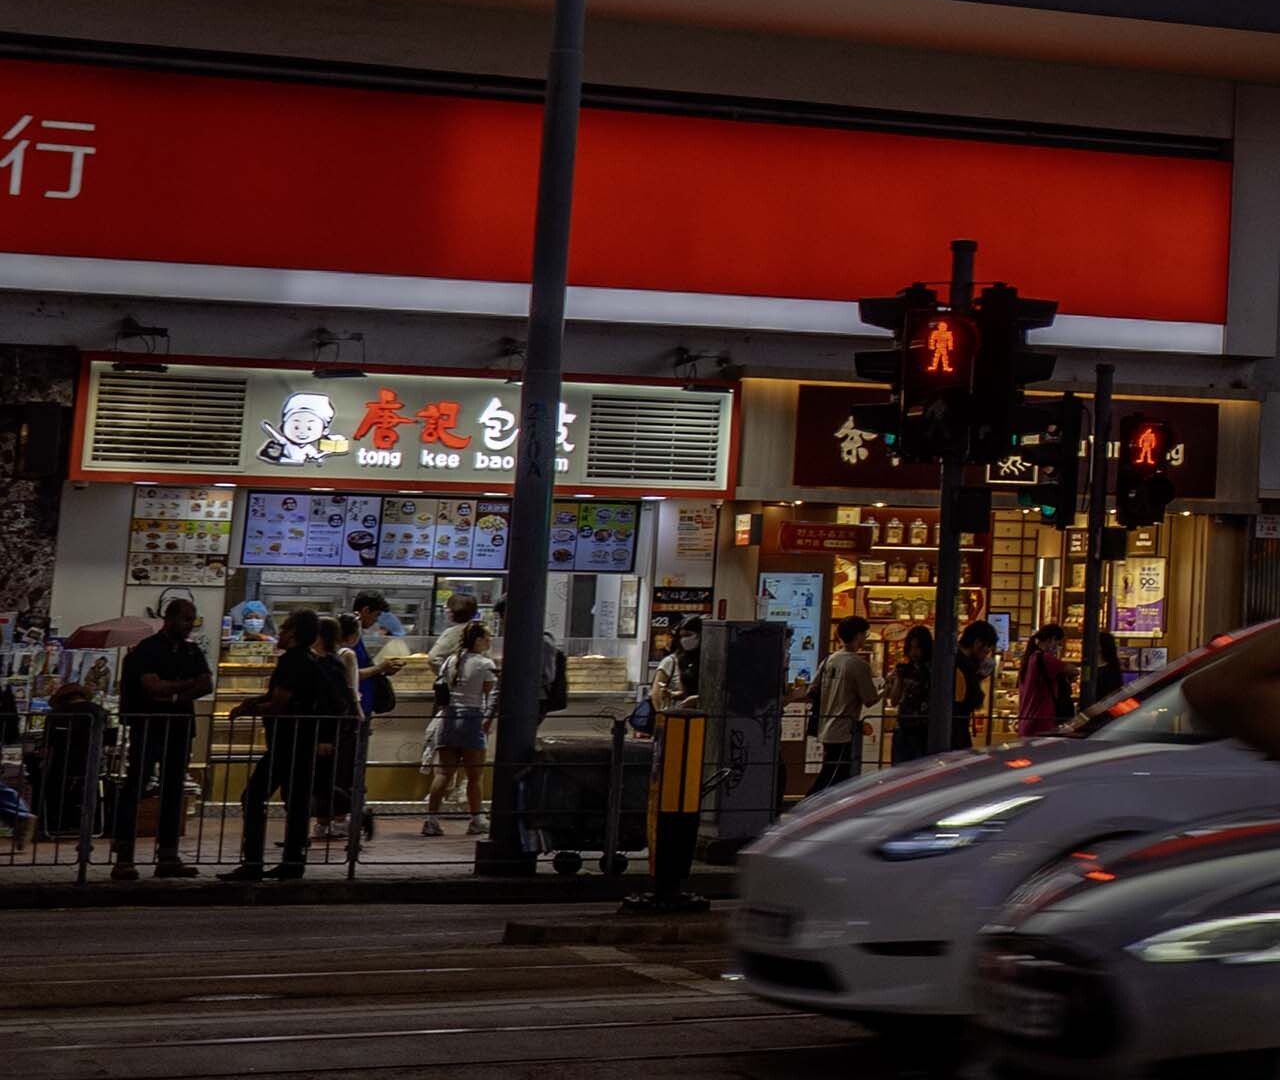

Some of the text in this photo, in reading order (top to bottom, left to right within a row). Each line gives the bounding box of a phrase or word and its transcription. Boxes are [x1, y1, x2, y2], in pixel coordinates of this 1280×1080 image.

[0, 115, 96, 199] 行
[356, 447, 515, 470] tong kee bao
